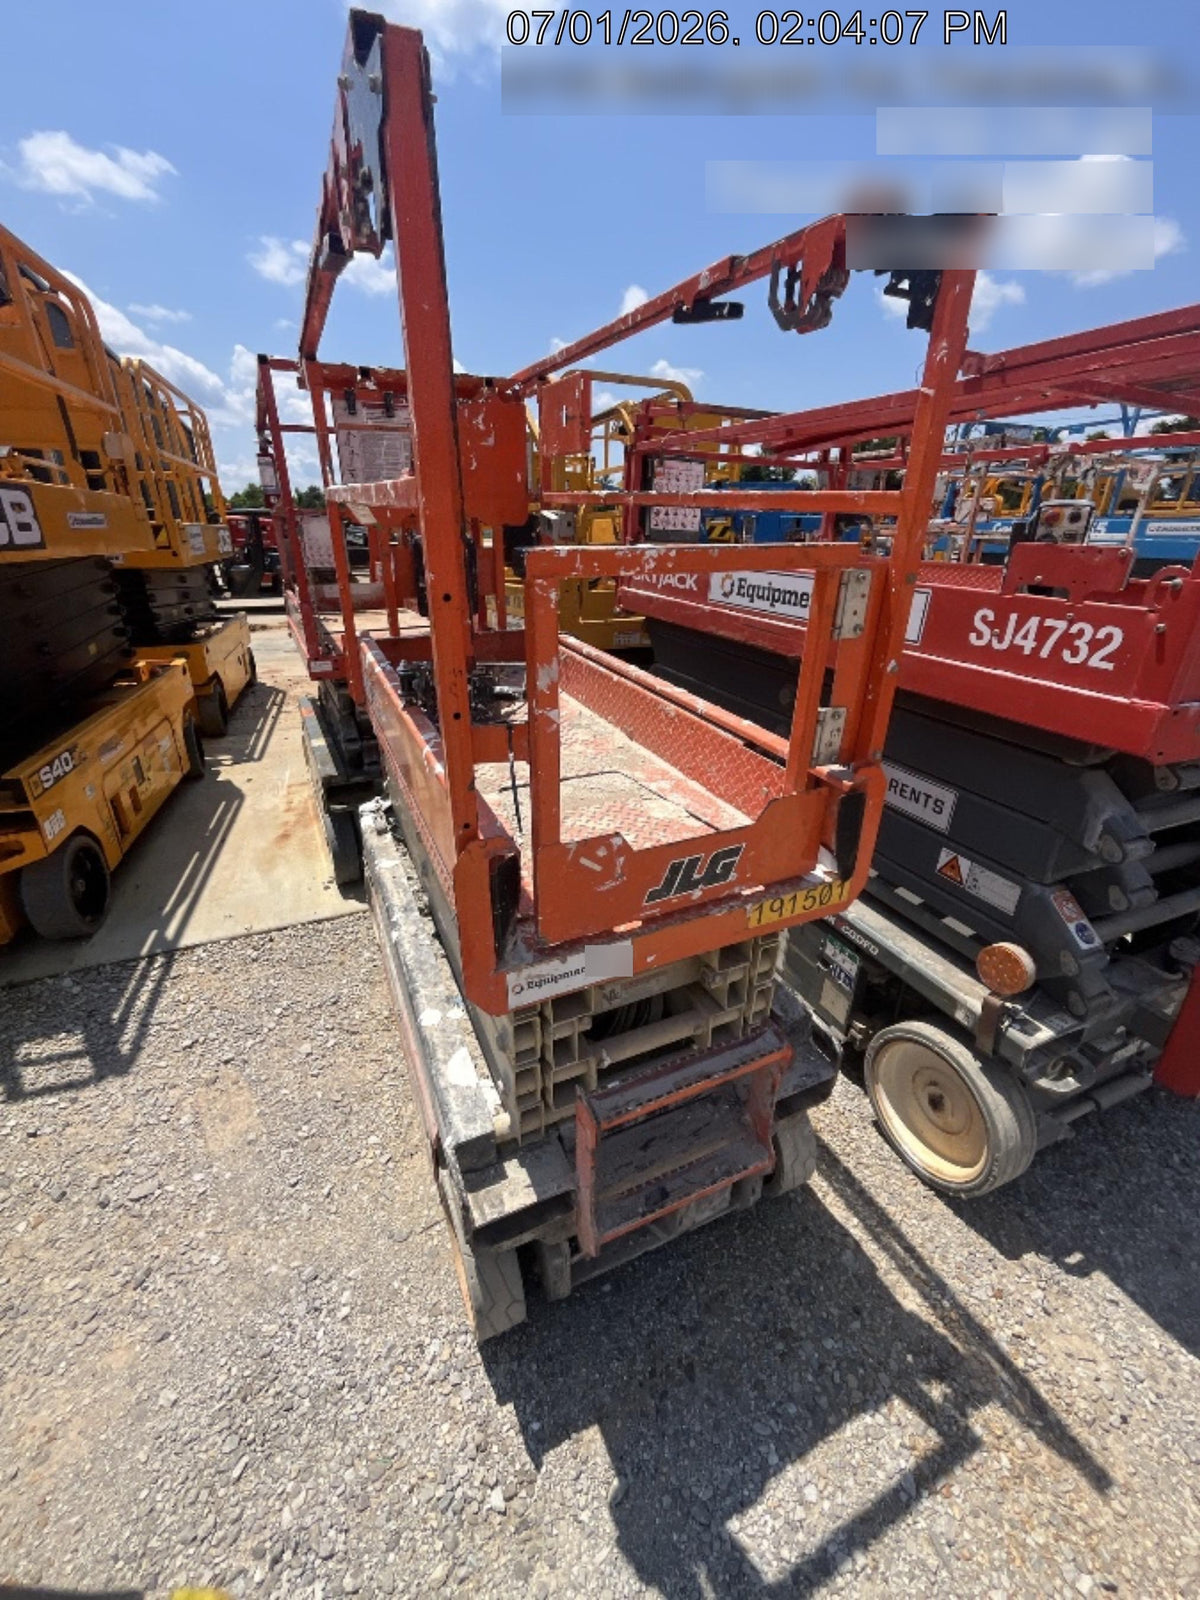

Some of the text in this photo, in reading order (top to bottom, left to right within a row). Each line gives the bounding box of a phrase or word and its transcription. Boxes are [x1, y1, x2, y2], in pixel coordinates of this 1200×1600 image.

[968, 607, 1124, 671] SJ4732
[888, 777, 945, 815] RENTS
[643, 843, 746, 906] JLG
[753, 881, 846, 925] 191501
